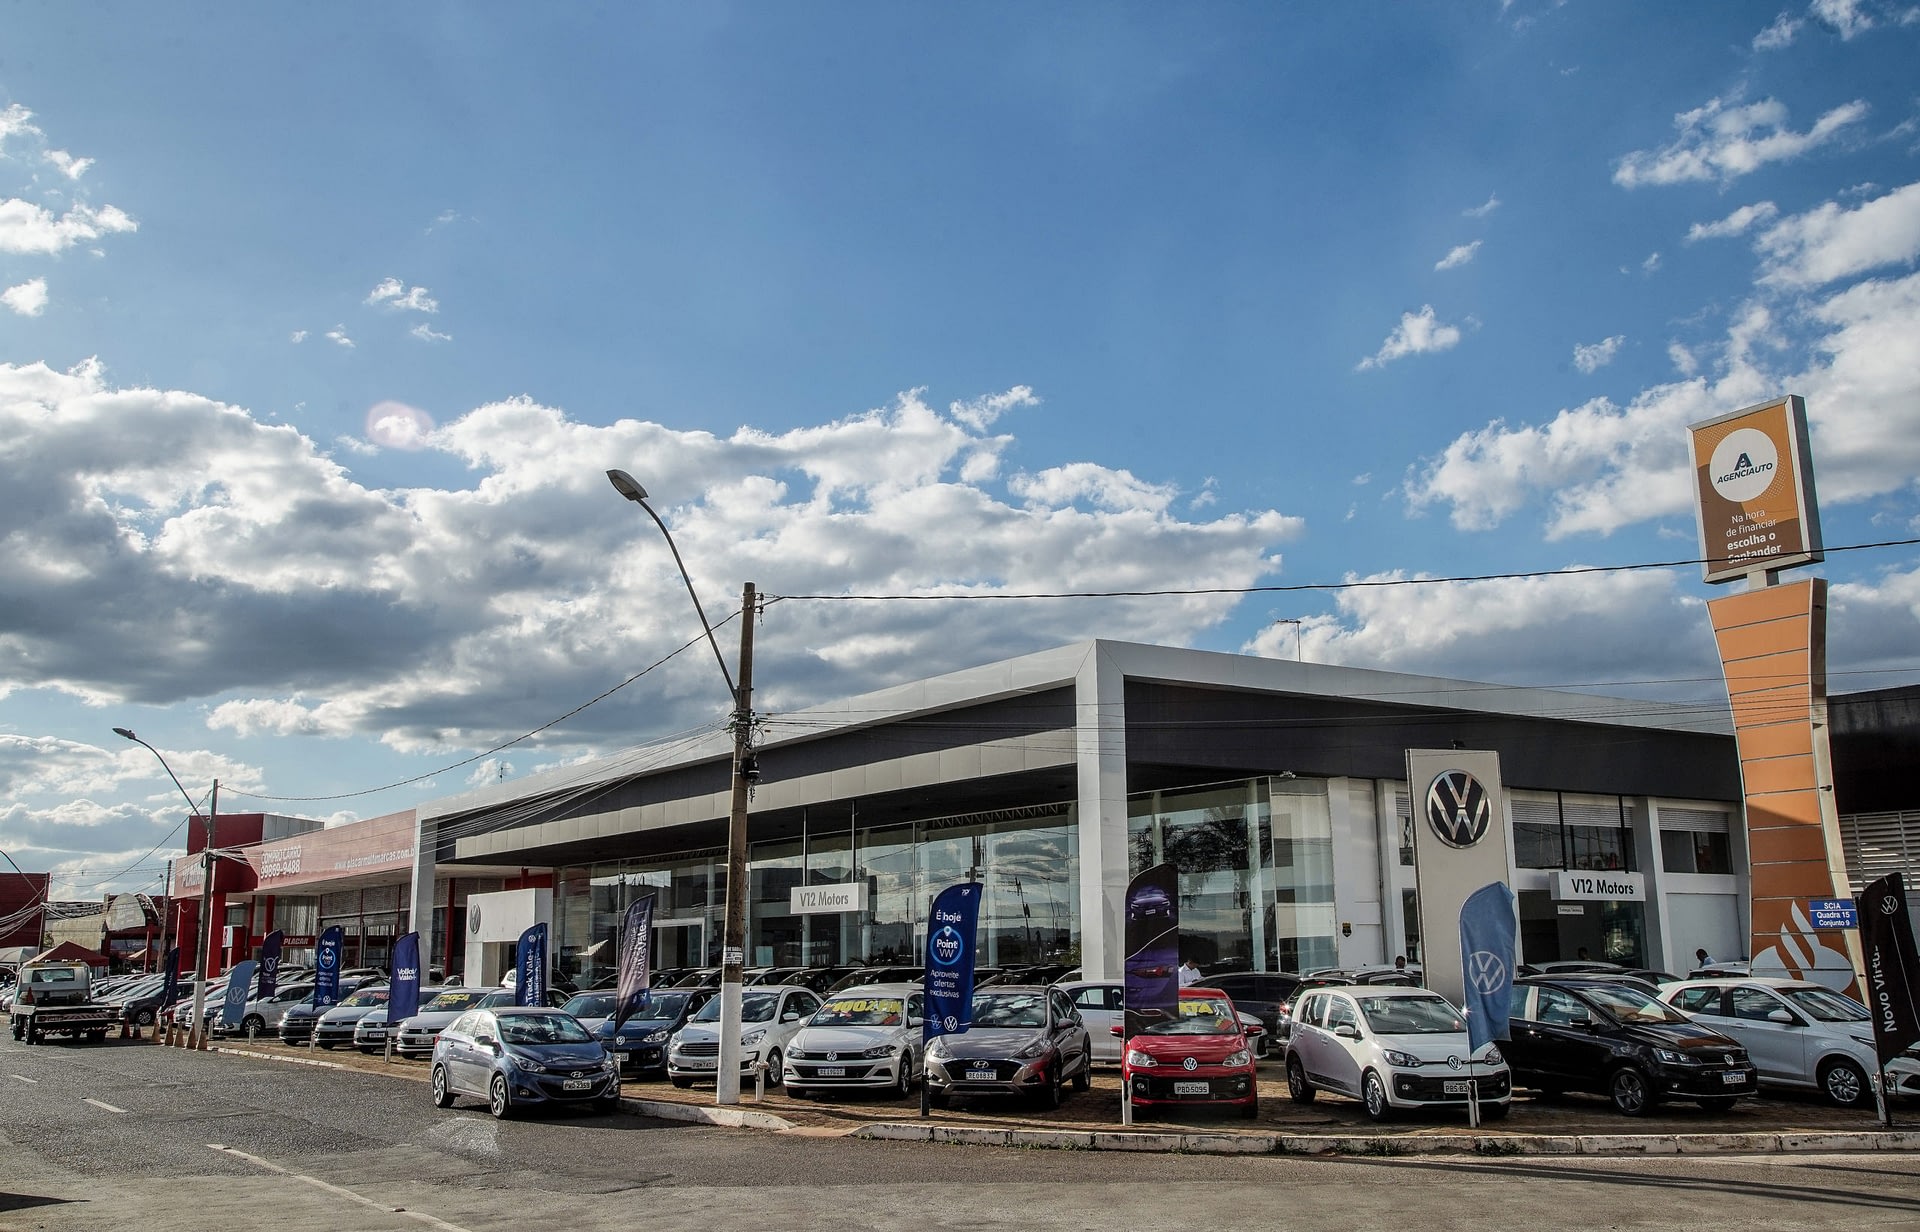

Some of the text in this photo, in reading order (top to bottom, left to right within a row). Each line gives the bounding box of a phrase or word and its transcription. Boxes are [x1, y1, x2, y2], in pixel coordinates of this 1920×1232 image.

[1717, 462, 1773, 484] AGENCIAUTO
[1731, 509, 1766, 524] Na hora
[1726, 518, 1777, 538] de financiar
[1727, 532, 1776, 550] escolha o
[1727, 544, 1782, 564] Santander
[1571, 878, 1634, 895] V12 Motors
[800, 891, 849, 907] V12 Motors
[1823, 902, 1842, 910] SCIA
[942, 913, 961, 923] hoje
[1816, 911, 1851, 919] Quadra 15
[1818, 919, 1845, 928] Conjunto
[936, 938, 958, 949] Point
[939, 948, 955, 958] VW
[930, 969, 959, 979] Aproveite
[933, 979, 955, 988] ofertas
[1872, 945, 1897, 1033] Novo Virtu
[929, 989, 959, 998] exclusivas
